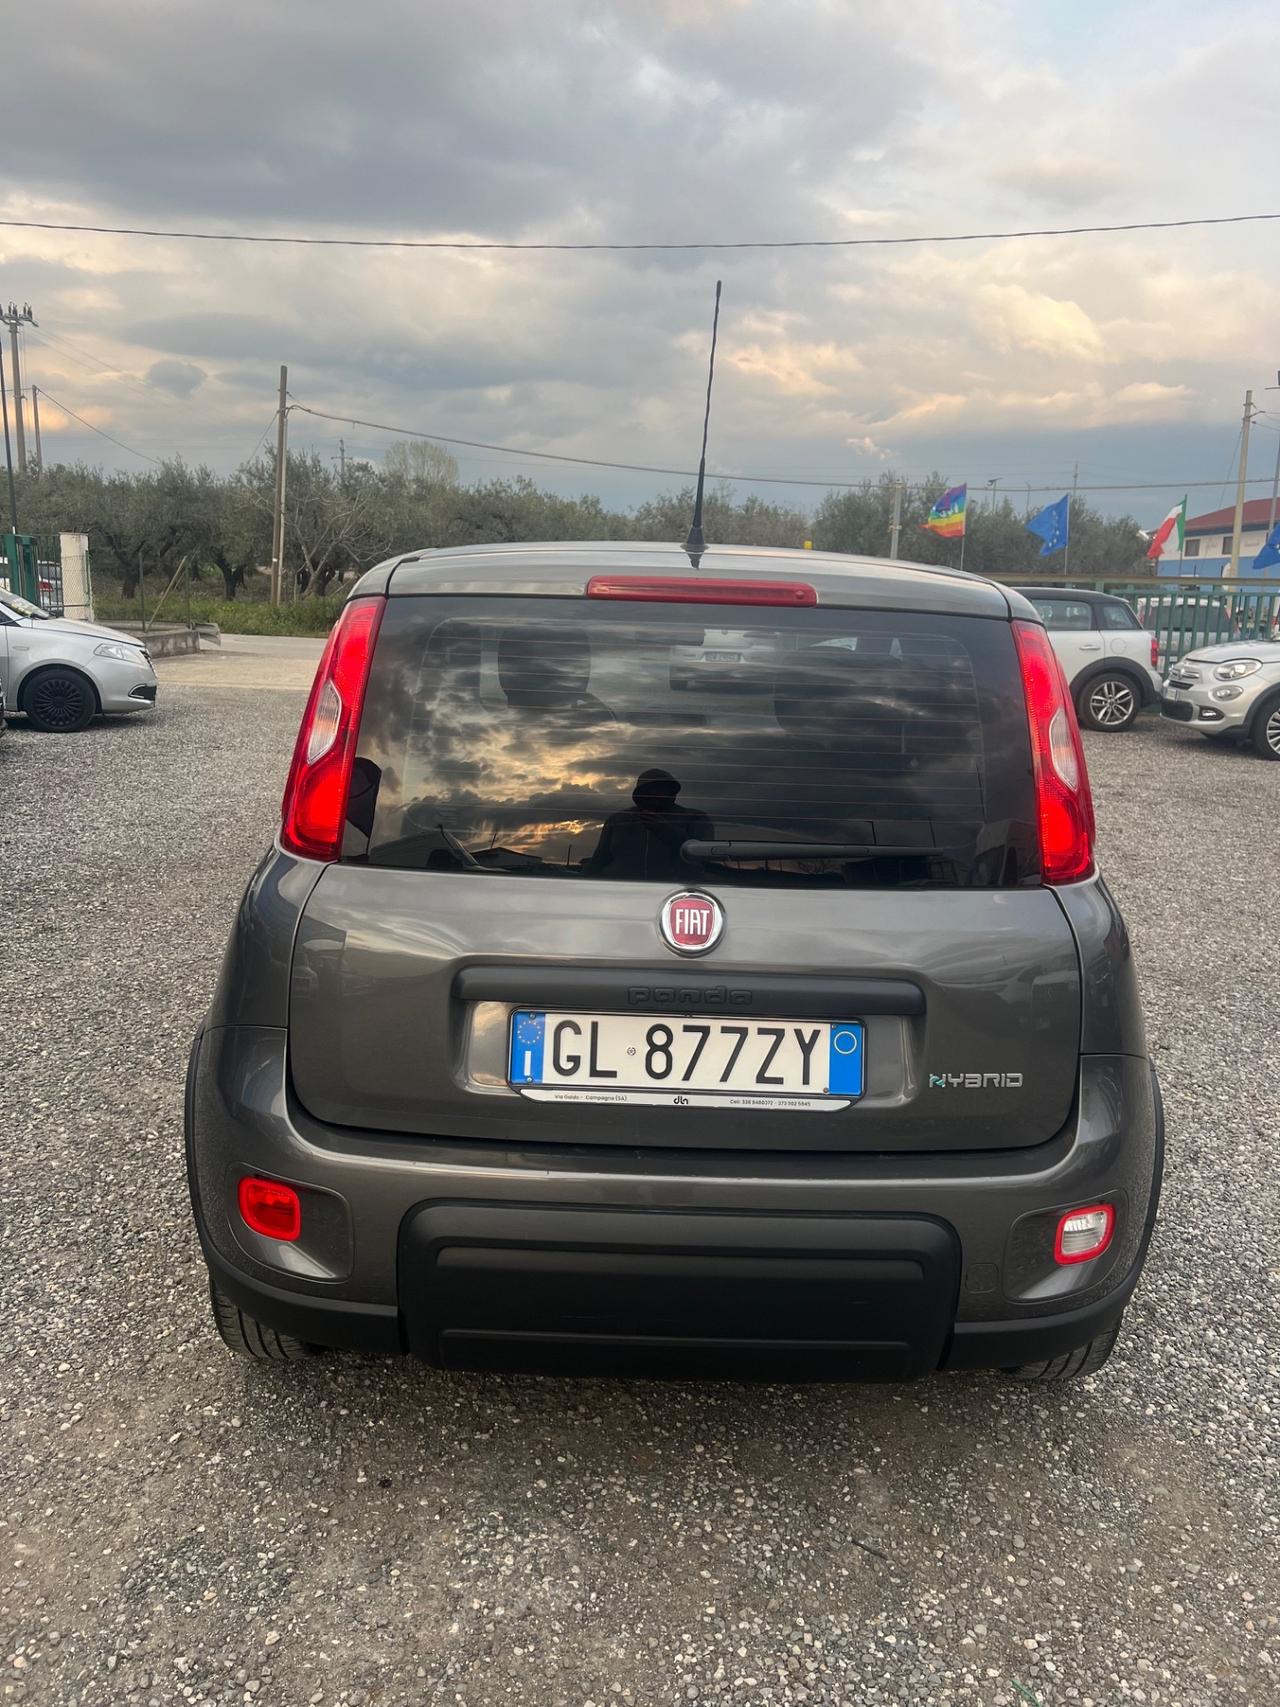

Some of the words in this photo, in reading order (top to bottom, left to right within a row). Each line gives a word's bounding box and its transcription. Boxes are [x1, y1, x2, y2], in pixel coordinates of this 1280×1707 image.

[675, 908, 710, 936] FIAT
[523, 1050, 532, 1076] I
[552, 1019, 618, 1079] GL
[645, 1022, 822, 1086] 877ZY
[928, 1072, 1024, 1089] HYBRID
